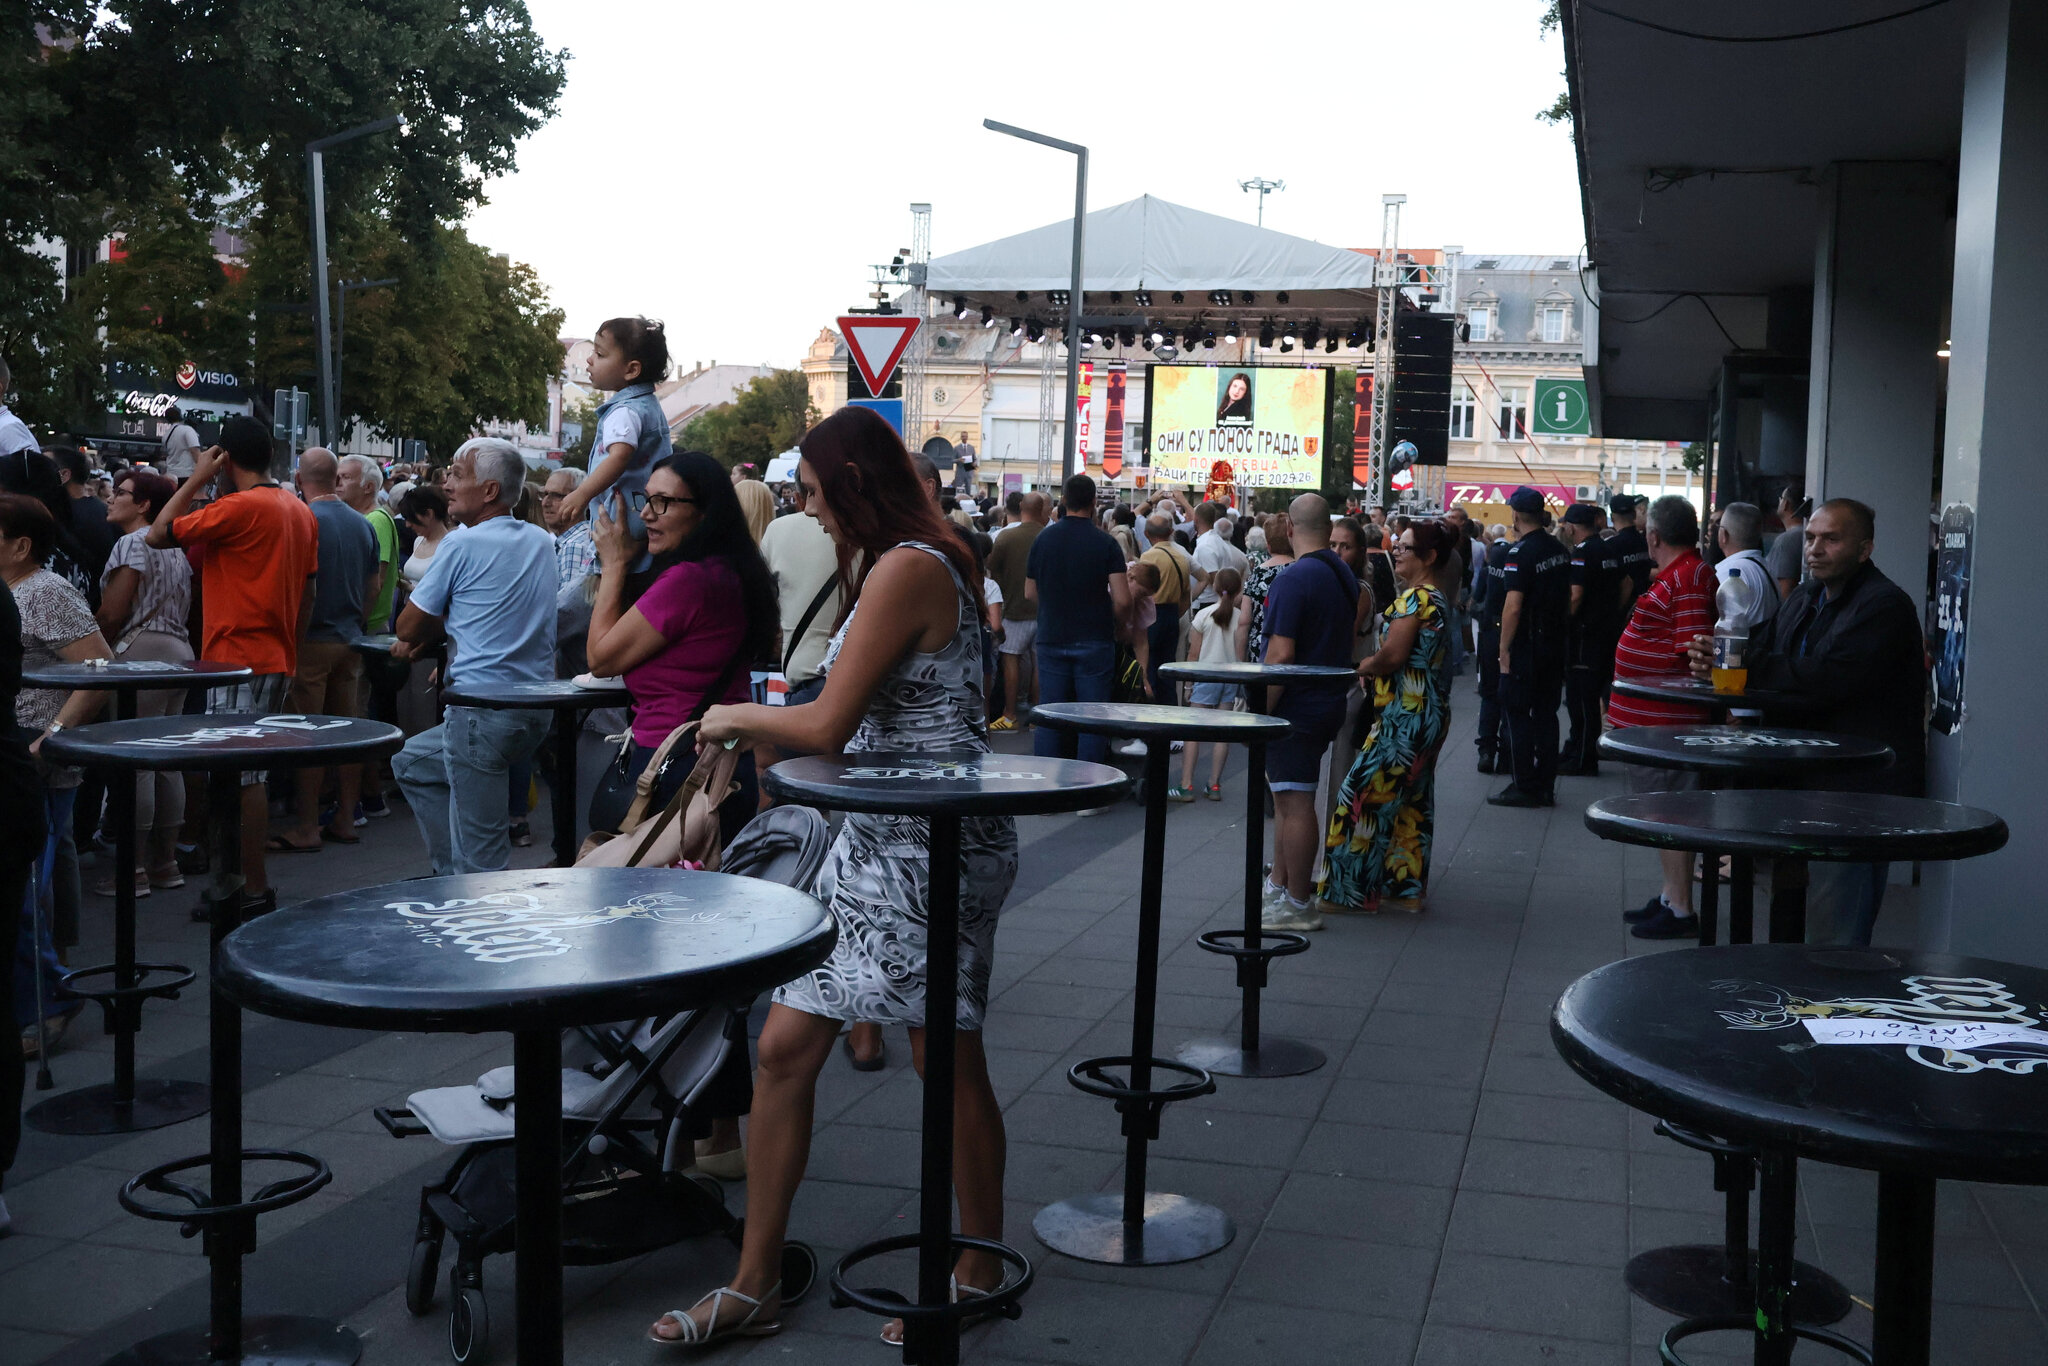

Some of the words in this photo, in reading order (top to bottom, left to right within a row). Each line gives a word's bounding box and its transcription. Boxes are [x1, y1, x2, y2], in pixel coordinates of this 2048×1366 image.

[1158, 431, 1184, 452] ОНИ
[1189, 429, 1205, 452] СУ
[1209, 428, 1254, 454] ПОНОС
[1258, 430, 1299, 459] ГРАДА
[404, 923, 442, 945] PIVO
